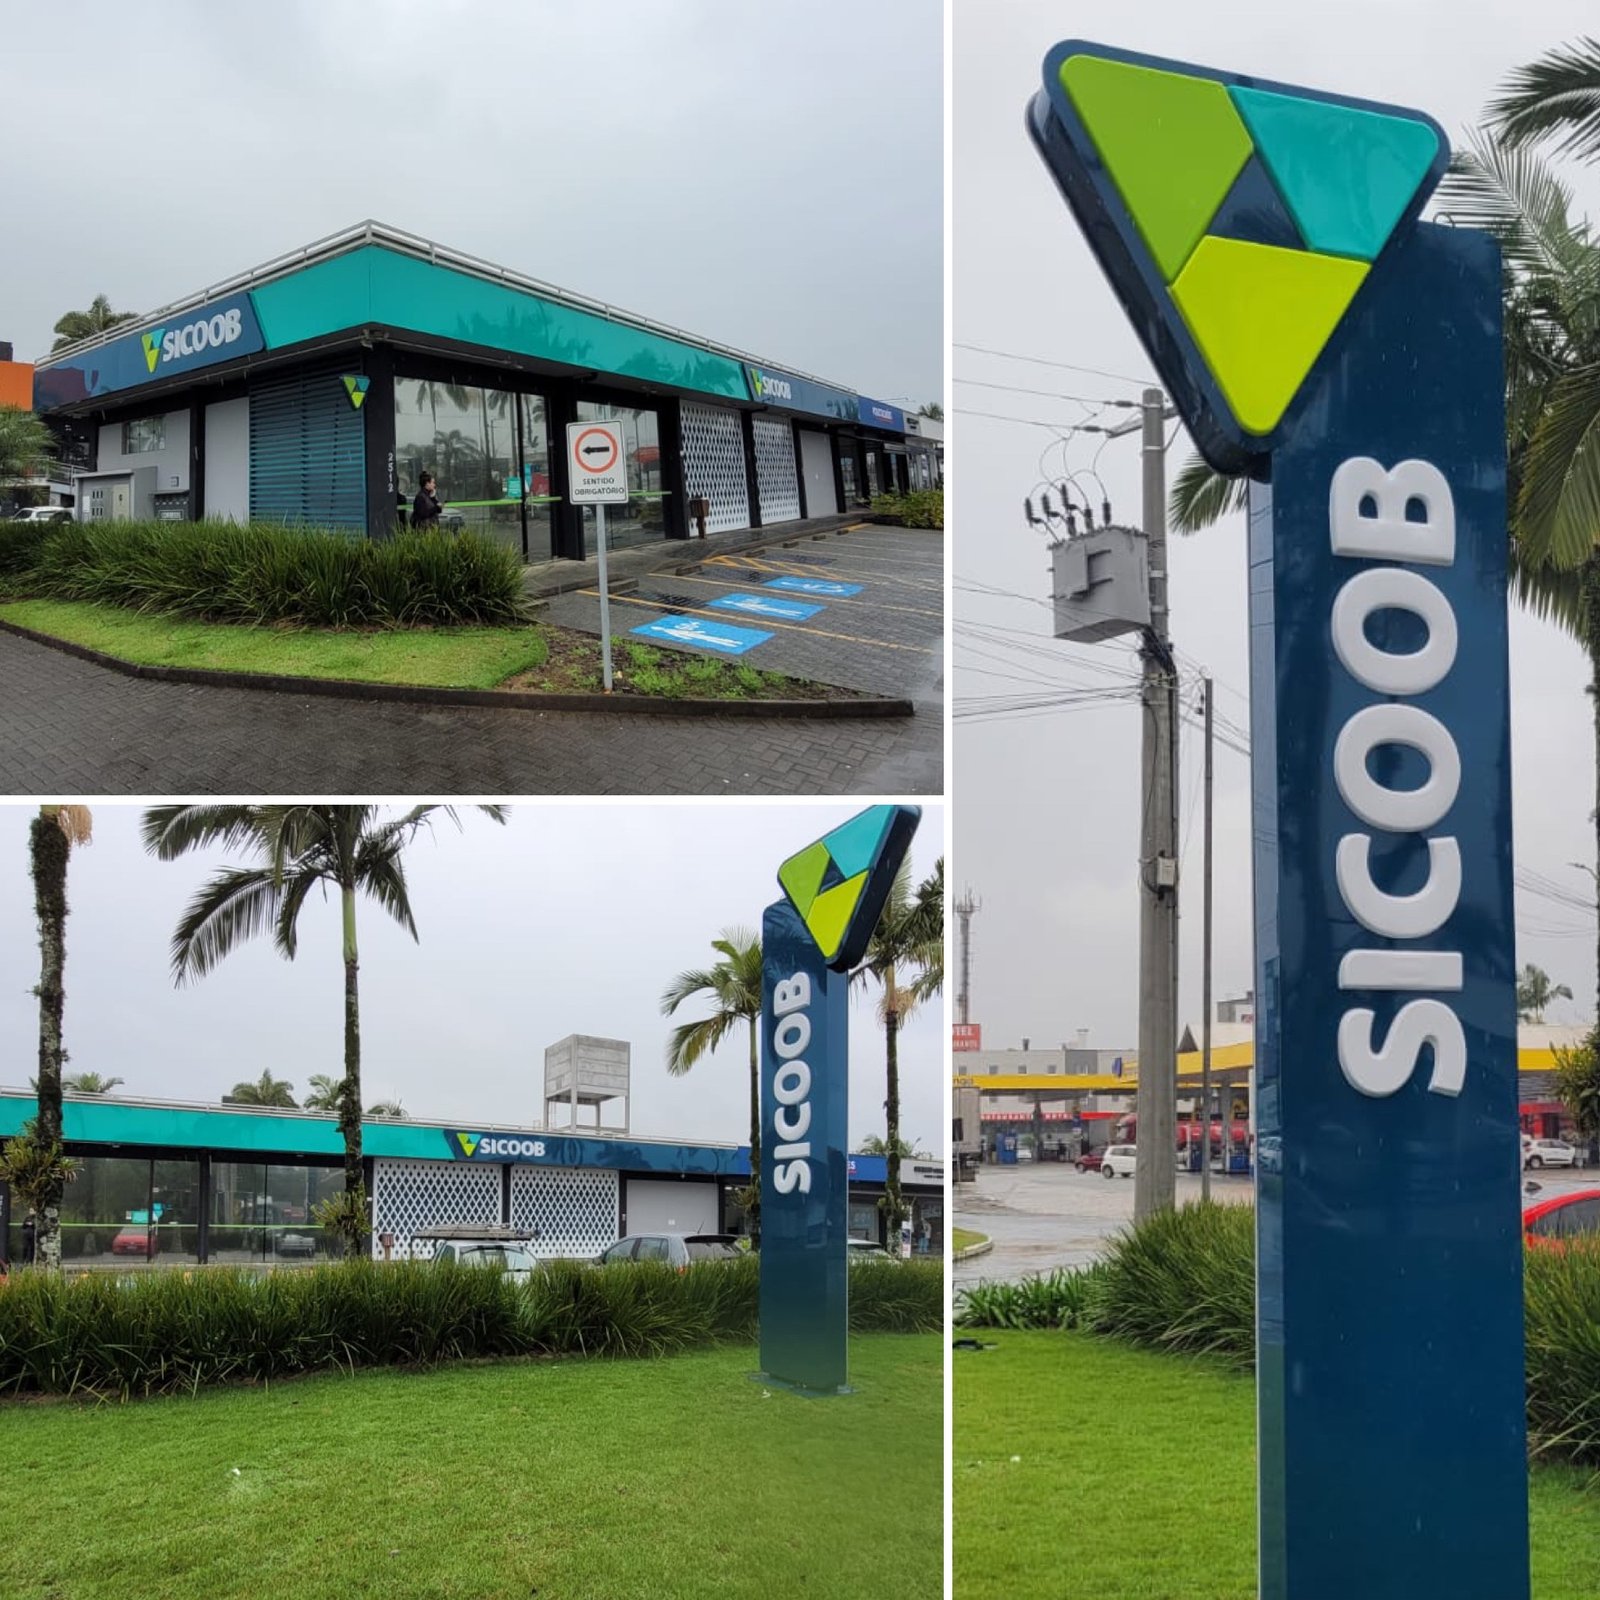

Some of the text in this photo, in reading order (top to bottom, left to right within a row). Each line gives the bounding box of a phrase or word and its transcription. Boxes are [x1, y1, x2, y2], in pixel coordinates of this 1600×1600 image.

[162, 308, 242, 362] SICOOB
[762, 376, 792, 401] SICOOB
[574, 487, 625, 496] OBRIGATÓRIO
[582, 477, 615, 485] SENTIDO
[1329, 456, 1468, 1098] SICOOB
[773, 971, 812, 1194] SICOOB
[479, 1137, 546, 1157] SICOOB
